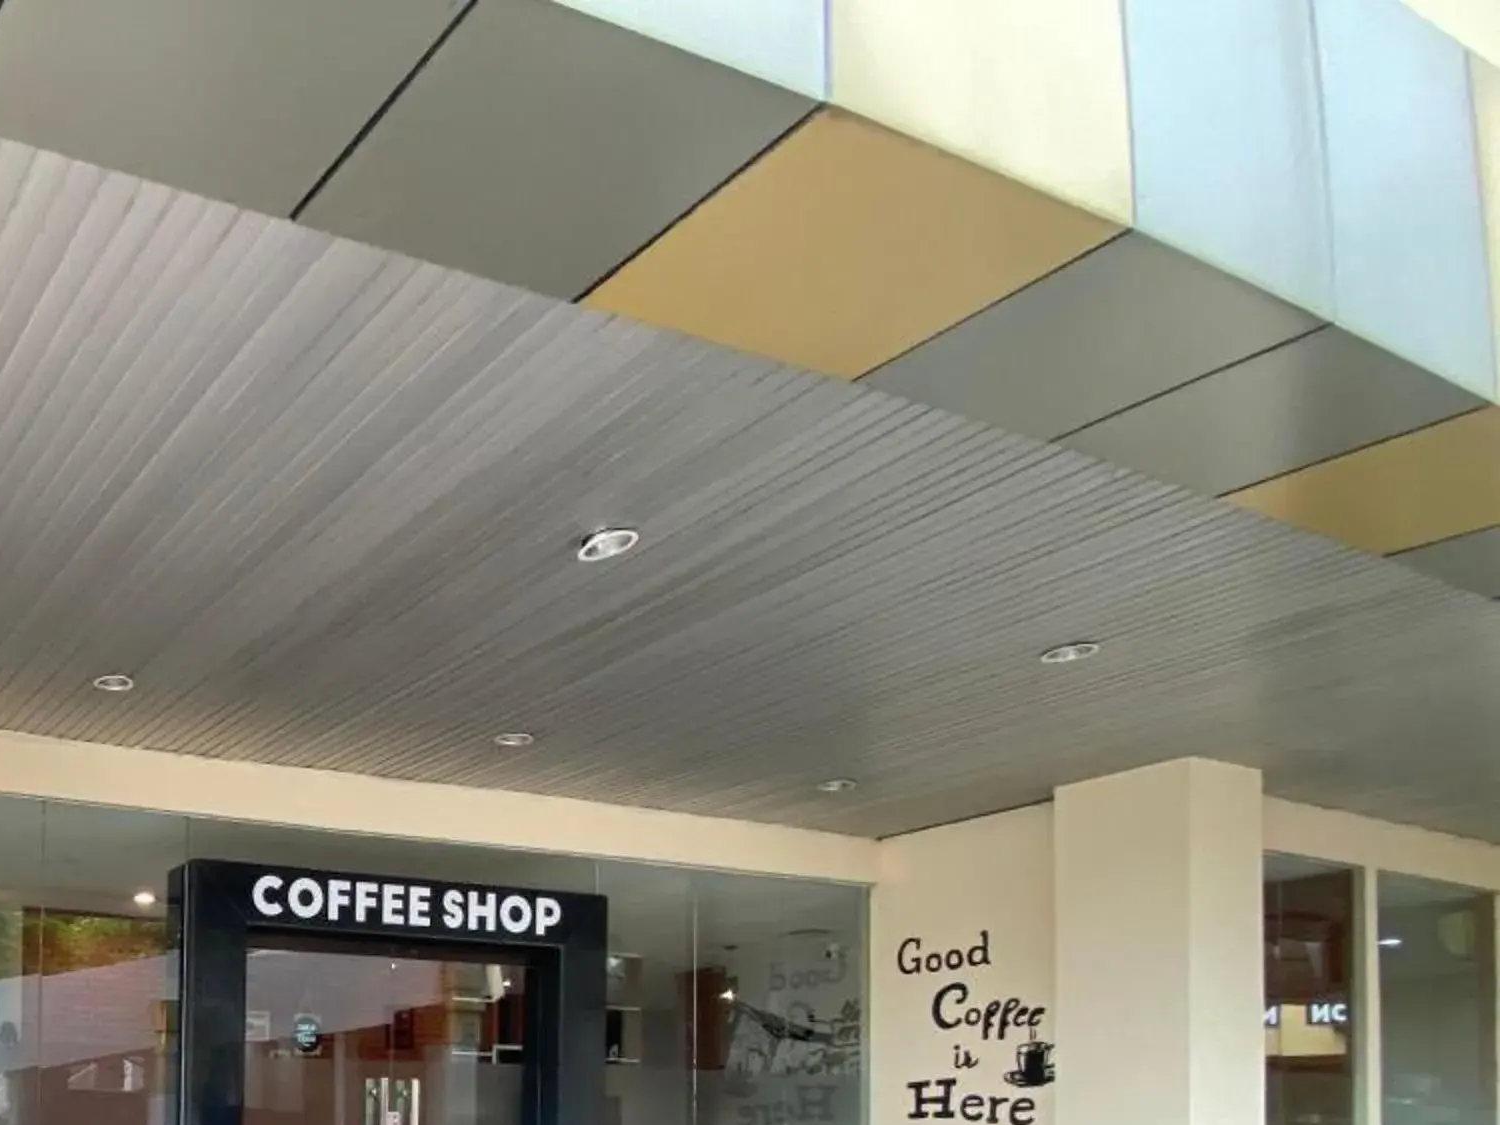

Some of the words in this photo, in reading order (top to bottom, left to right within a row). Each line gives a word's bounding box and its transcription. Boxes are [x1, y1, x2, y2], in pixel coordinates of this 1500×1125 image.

[252, 875, 431, 927] COFFEE
[442, 889, 562, 936] SHOP
[897, 930, 991, 974] Good
[932, 982, 1046, 1040] Coffee
[953, 1044, 979, 1069] is
[907, 1077, 1035, 1125] Here
